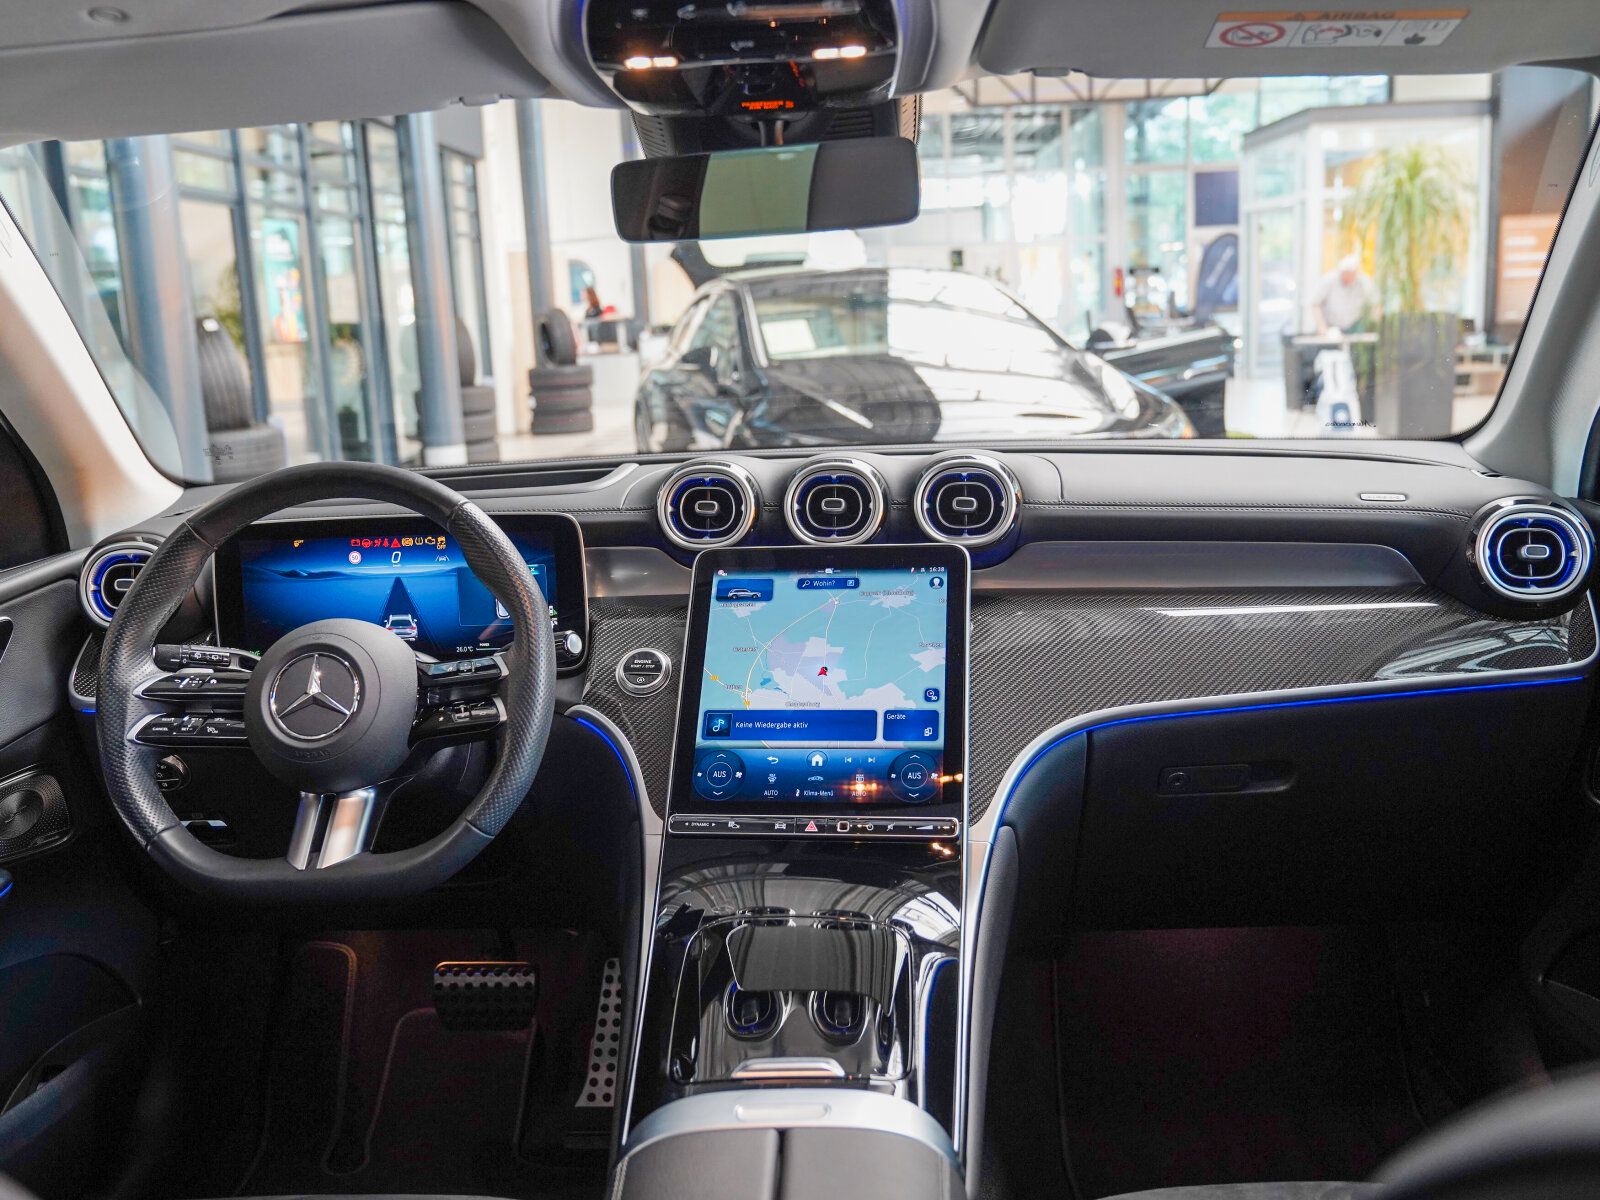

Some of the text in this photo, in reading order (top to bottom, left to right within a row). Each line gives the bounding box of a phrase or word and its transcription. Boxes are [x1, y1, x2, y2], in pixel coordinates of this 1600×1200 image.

[1317, 11, 1395, 20] AIRBAG
[391, 551, 401, 563] 0
[735, 721, 809, 730] Keine Wiedergabe aktiv
[712, 770, 727, 778] AUS
